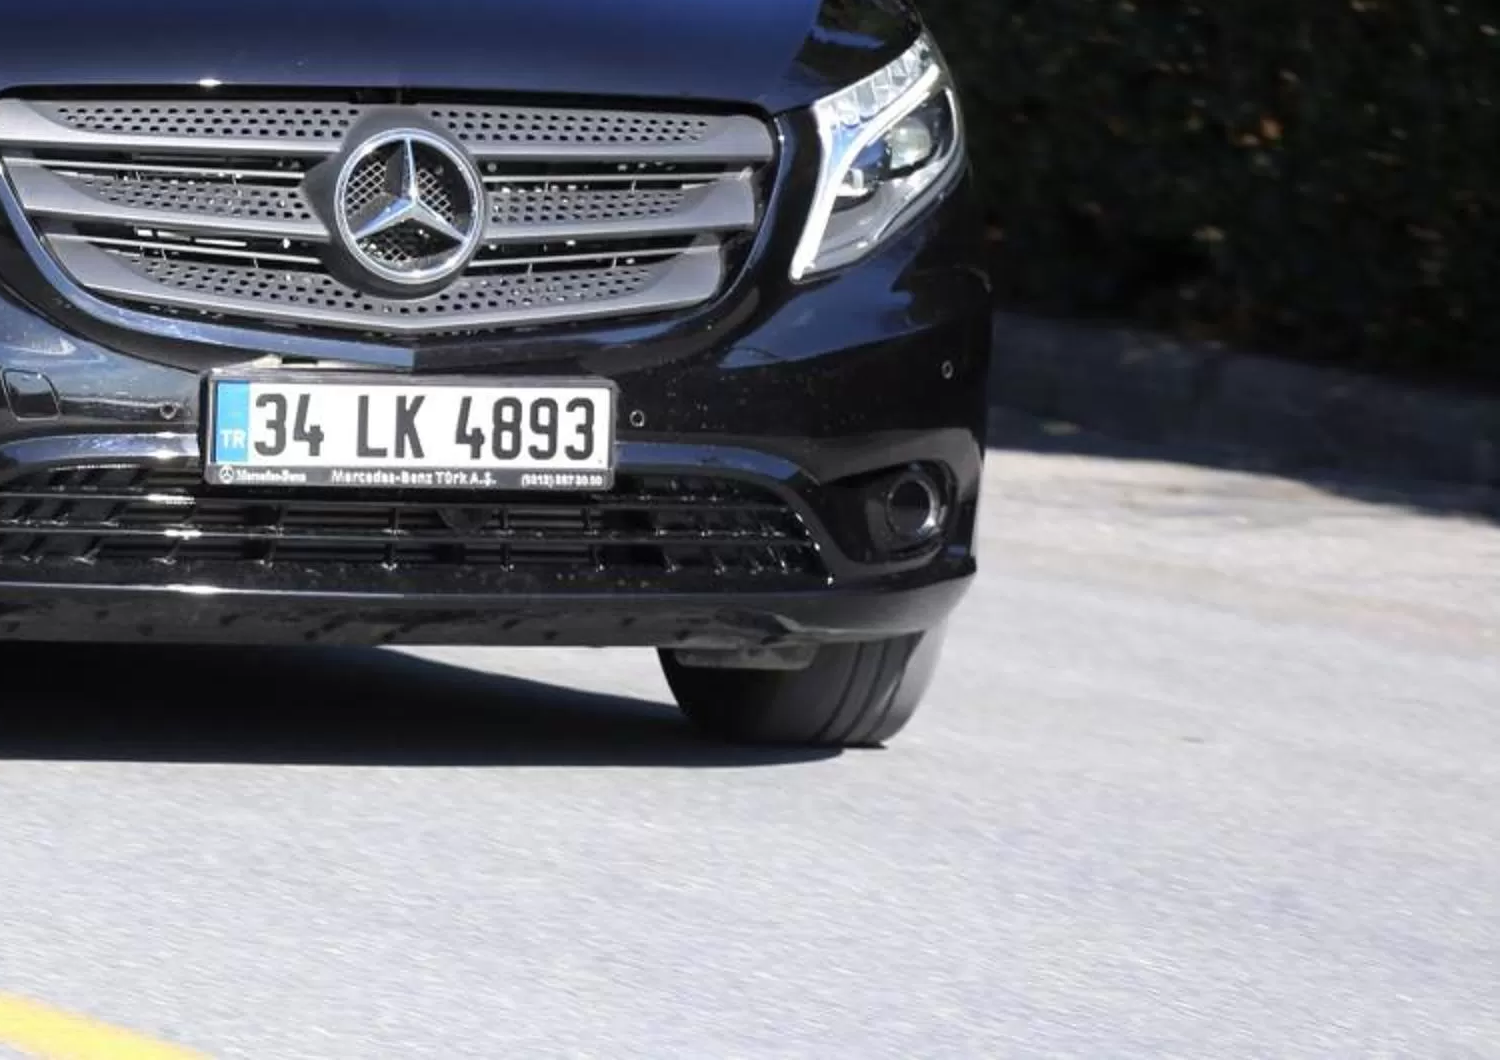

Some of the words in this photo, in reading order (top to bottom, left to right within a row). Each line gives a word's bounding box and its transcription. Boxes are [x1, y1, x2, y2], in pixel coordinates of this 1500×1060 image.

[220, 428, 246, 449] TR
[254, 393, 325, 457] 34
[357, 394, 426, 459] LK
[455, 395, 595, 461] 4893
